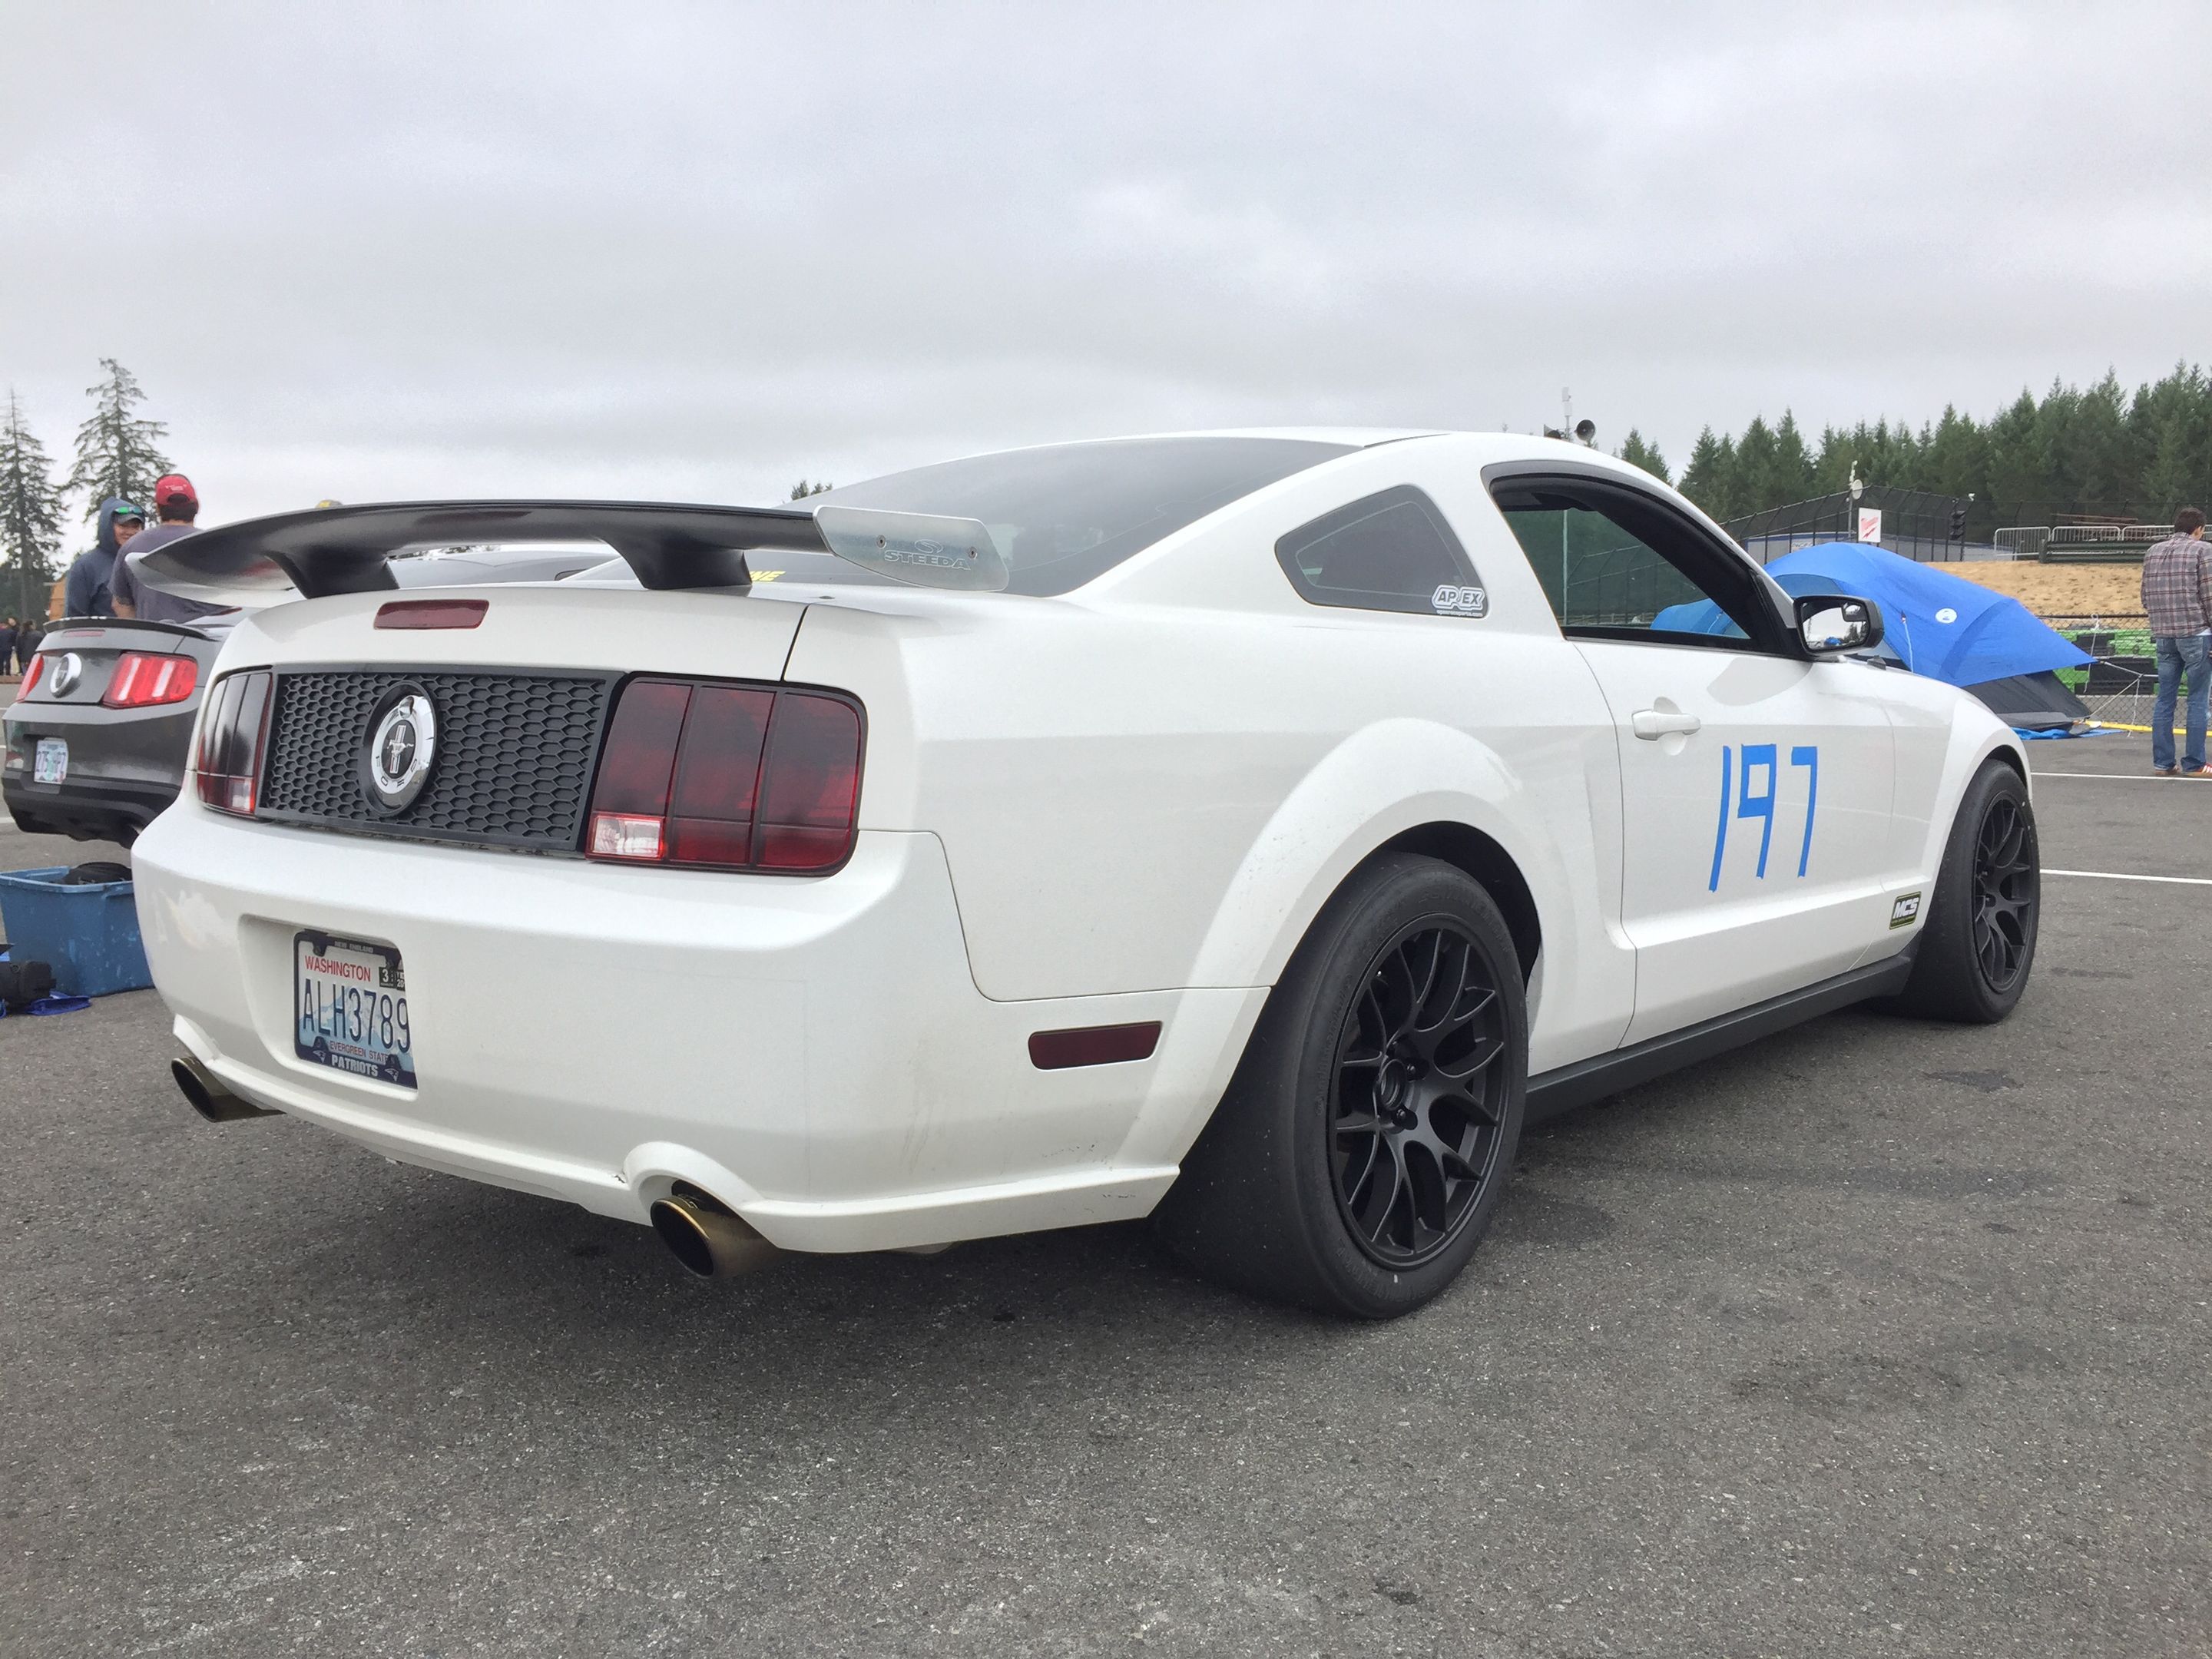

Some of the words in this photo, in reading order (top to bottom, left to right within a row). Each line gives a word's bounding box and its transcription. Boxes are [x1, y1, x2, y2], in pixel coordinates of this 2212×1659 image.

[884, 549, 971, 571] STEEDA
[1435, 588, 1482, 608] APEX
[1709, 743, 1818, 893] 197
[1892, 897, 1919, 919] MCS
[304, 955, 371, 982] WASHINGTON
[303, 978, 411, 1054] ALH3789
[329, 1041, 366, 1057] EVERGREEN
[331, 1054, 379, 1077] PATRIOTS
